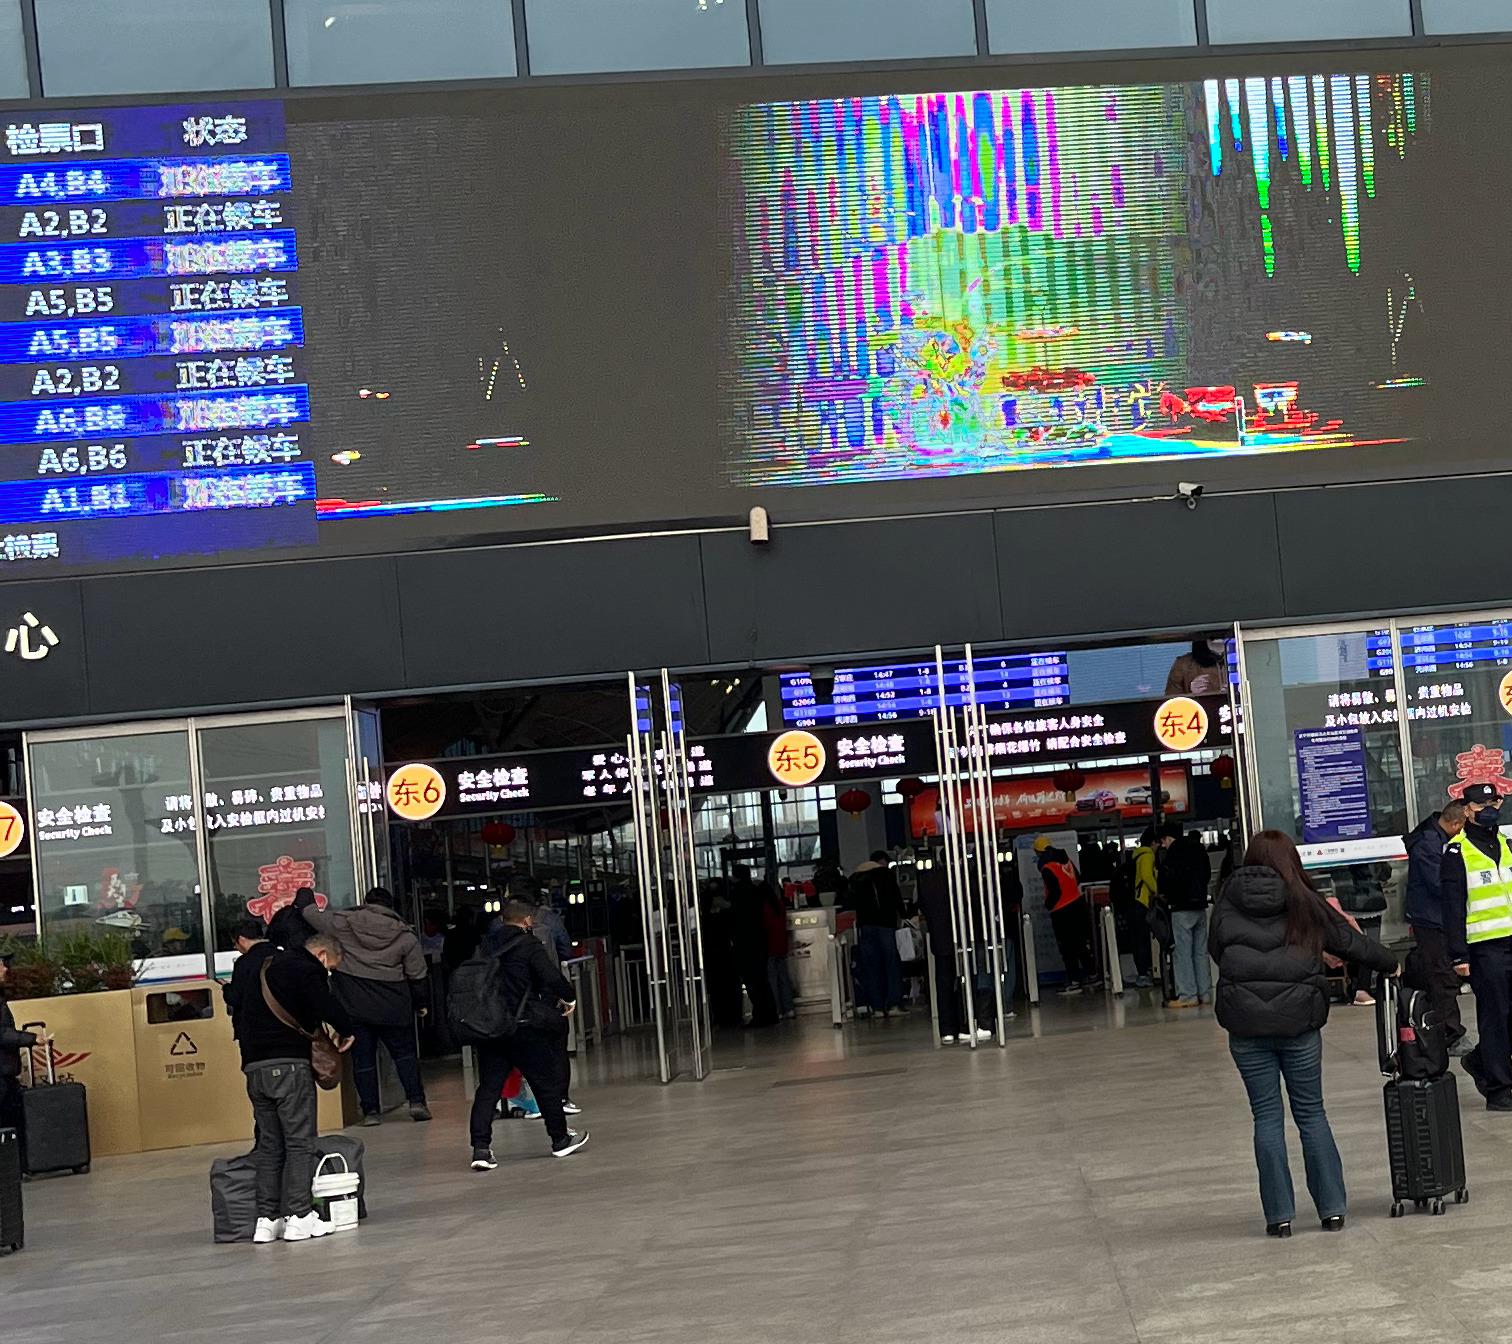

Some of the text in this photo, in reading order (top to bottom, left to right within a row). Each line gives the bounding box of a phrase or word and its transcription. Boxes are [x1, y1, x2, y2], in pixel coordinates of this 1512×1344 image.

[6, 115, 248, 155] 检票口 状态
[19, 208, 108, 239] A2,B2
[25, 287, 115, 318] A5,B5
[31, 365, 120, 396] A2,B2
[38, 444, 127, 475] A6,B6
[5, 612, 59, 660] 心
[1159, 711, 1204, 739] 东4
[775, 744, 820, 772] 东5
[837, 733, 905, 757] 安全检查
[838, 754, 906, 769] Security Check
[393, 777, 441, 806] 东6
[458, 766, 529, 791] 安全检查
[459, 787, 530, 803] Security Check
[37, 802, 112, 828] 安全检查
